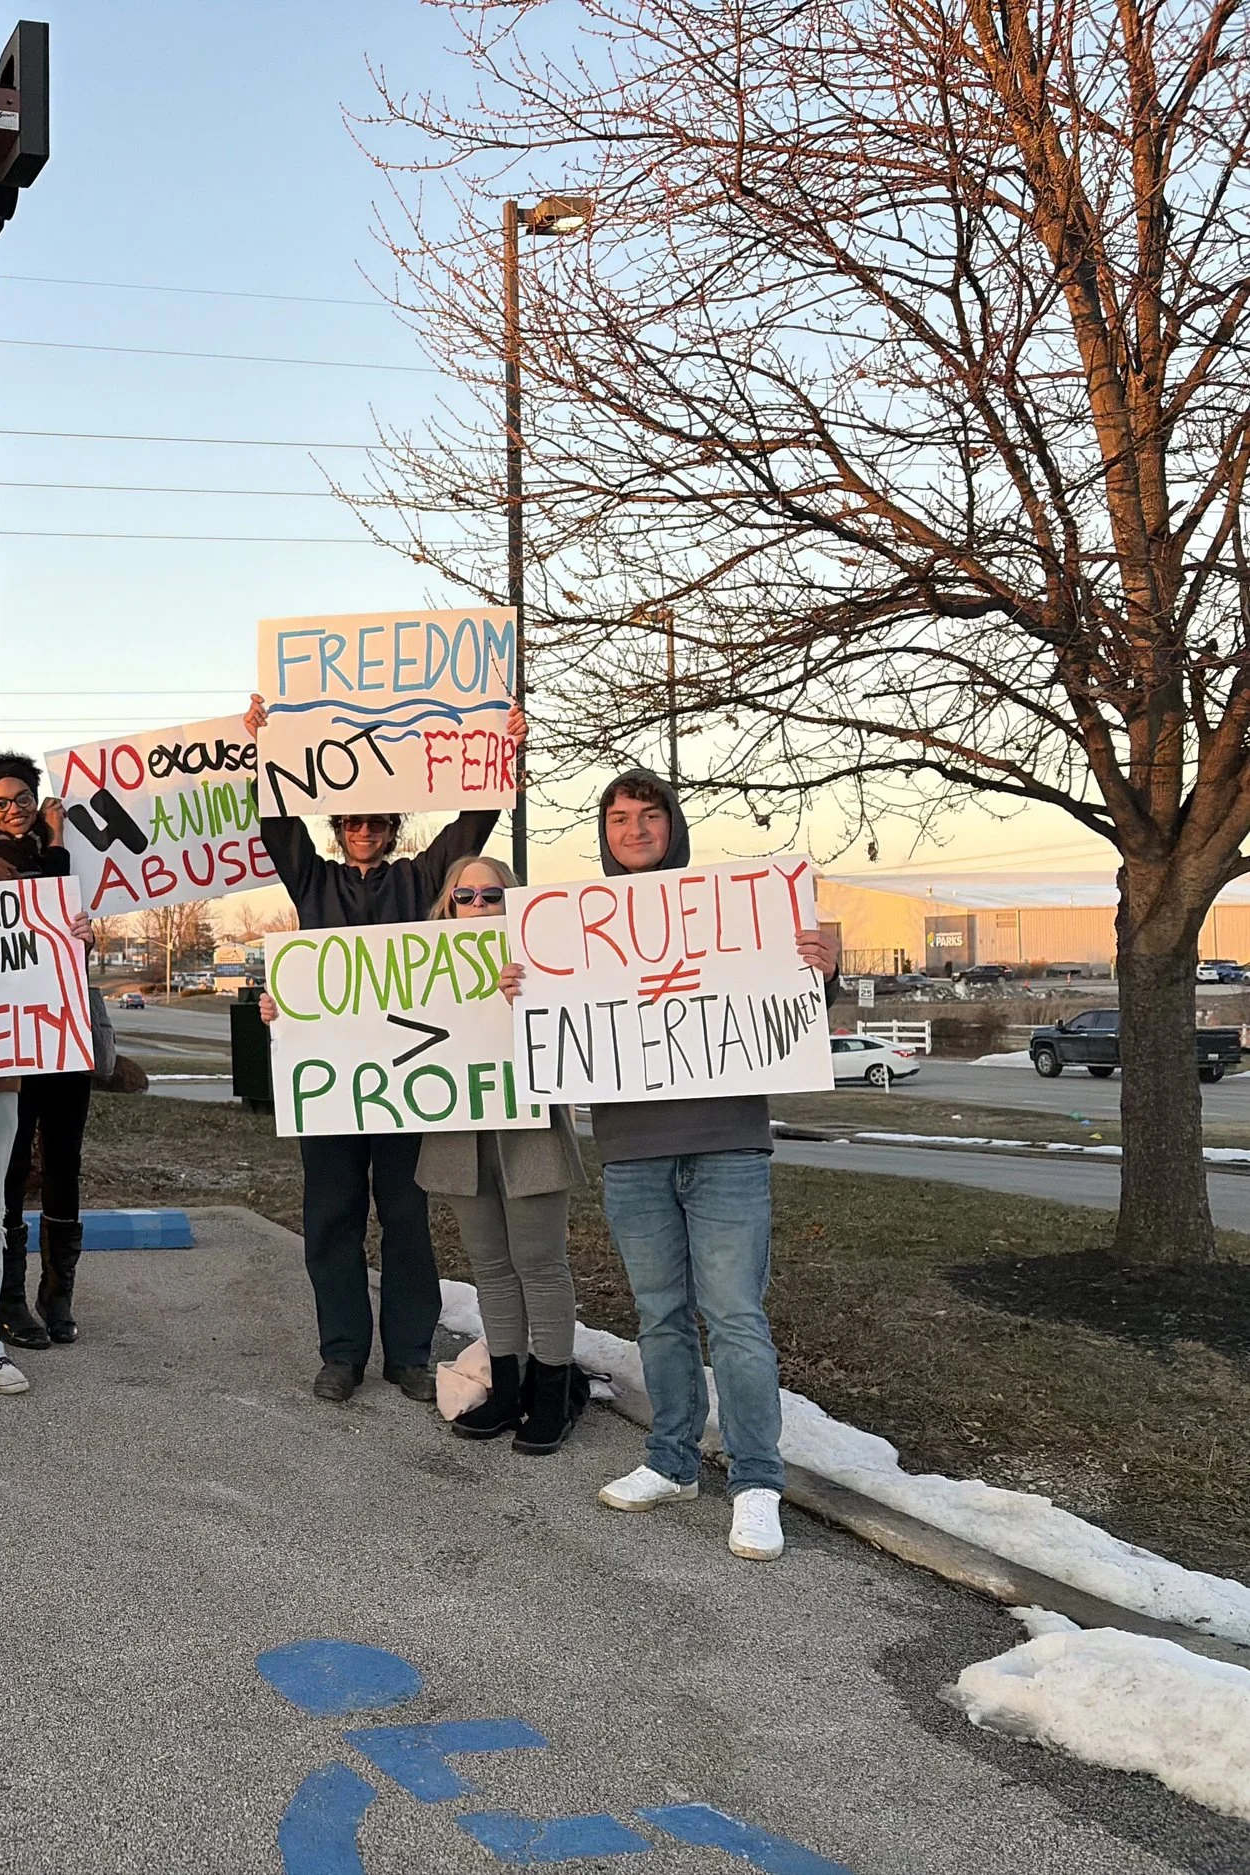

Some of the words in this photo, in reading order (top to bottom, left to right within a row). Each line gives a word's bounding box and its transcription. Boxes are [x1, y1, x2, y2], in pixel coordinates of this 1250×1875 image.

[277, 618, 515, 697] FREEDOM
[60, 743, 145, 798] NO
[147, 739, 258, 779] excuse
[265, 725, 395, 817] NOT
[423, 729, 516, 794] FEAR
[149, 777, 261, 846] ANIMA
[90, 836, 278, 911] ABUSE
[520, 861, 809, 976] CRUELTY
[935, 936, 964, 947] PARKS
[270, 929, 512, 1021] COMPASSI
[860, 989, 873, 998] 25
[525, 965, 822, 1095] ENTERTAINMENT
[292, 1059, 541, 1133] PROFI
